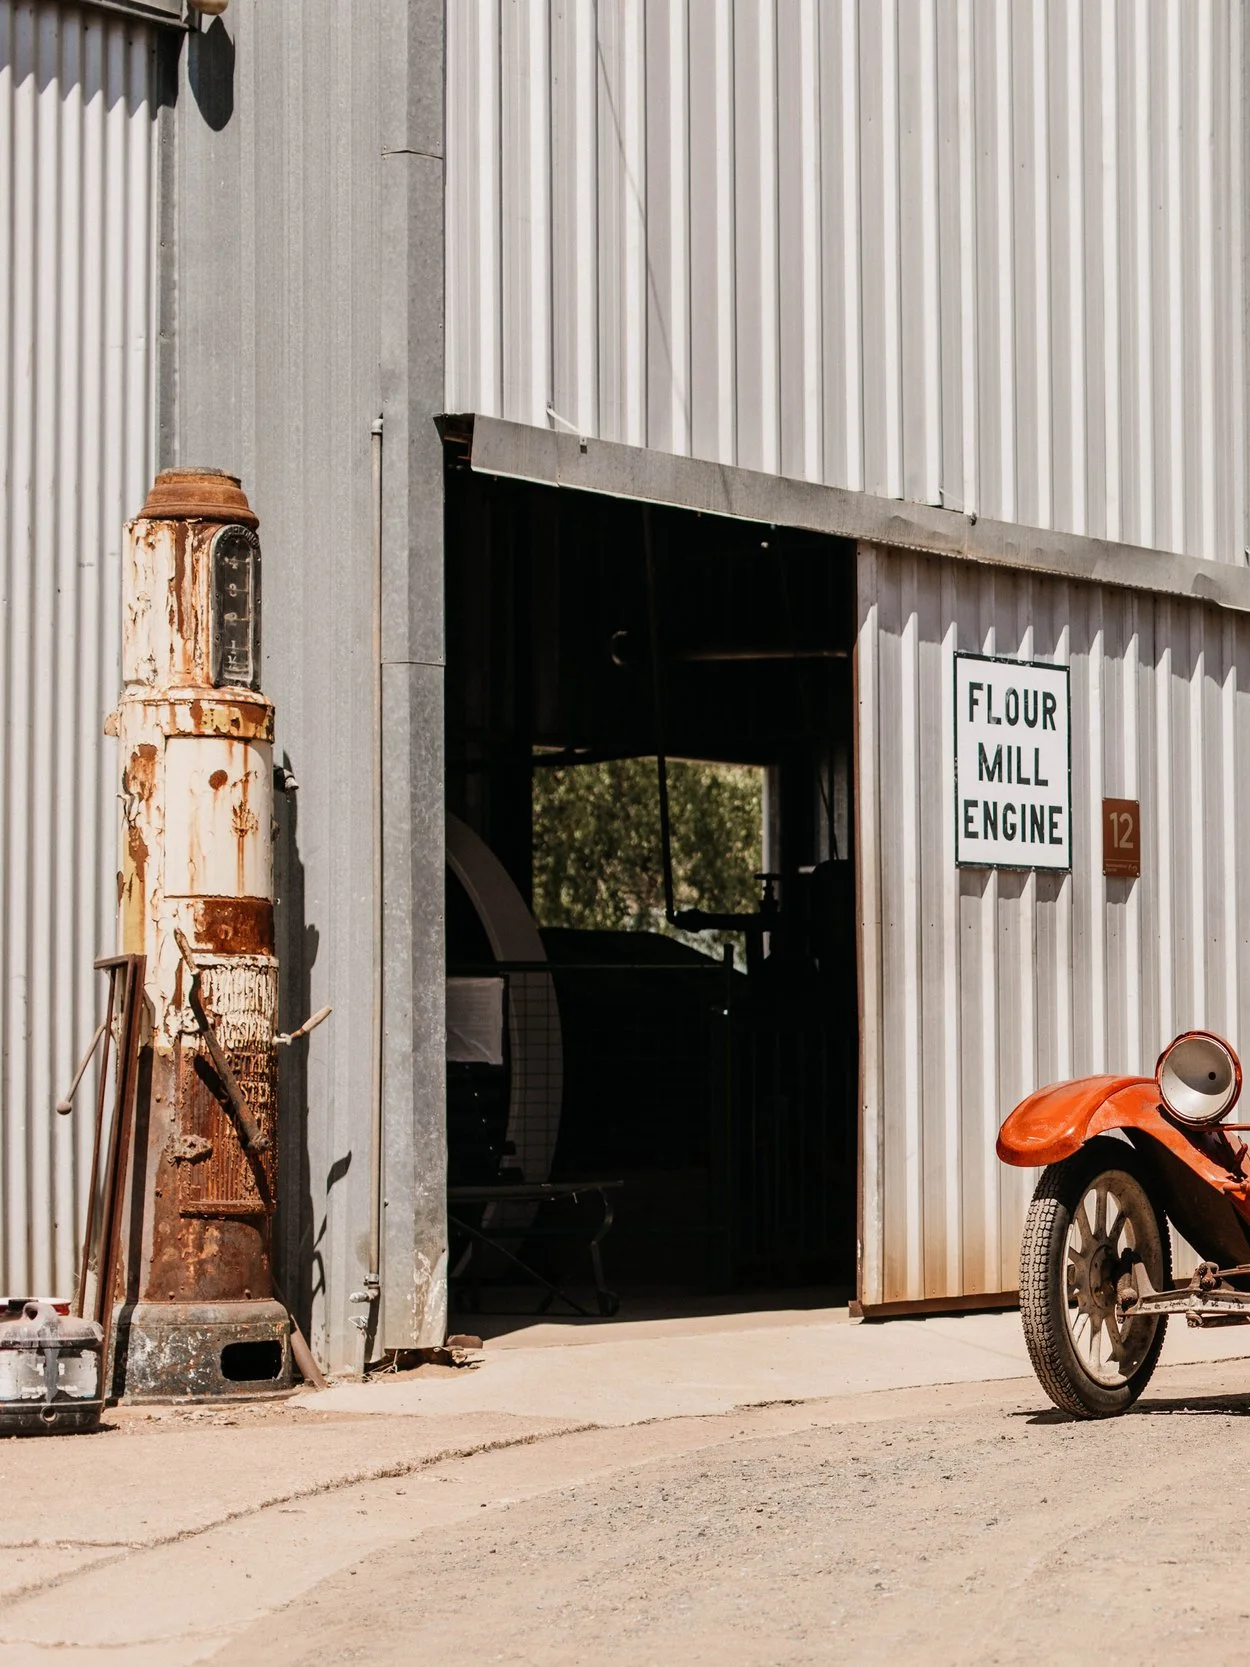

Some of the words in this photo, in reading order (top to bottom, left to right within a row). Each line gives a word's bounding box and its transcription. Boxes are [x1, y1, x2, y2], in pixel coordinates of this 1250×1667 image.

[968, 681, 1057, 731] FLOUR
[978, 742, 1049, 787] MILL
[963, 799, 1063, 845] ENGINE
[1109, 811, 1134, 849] 12
